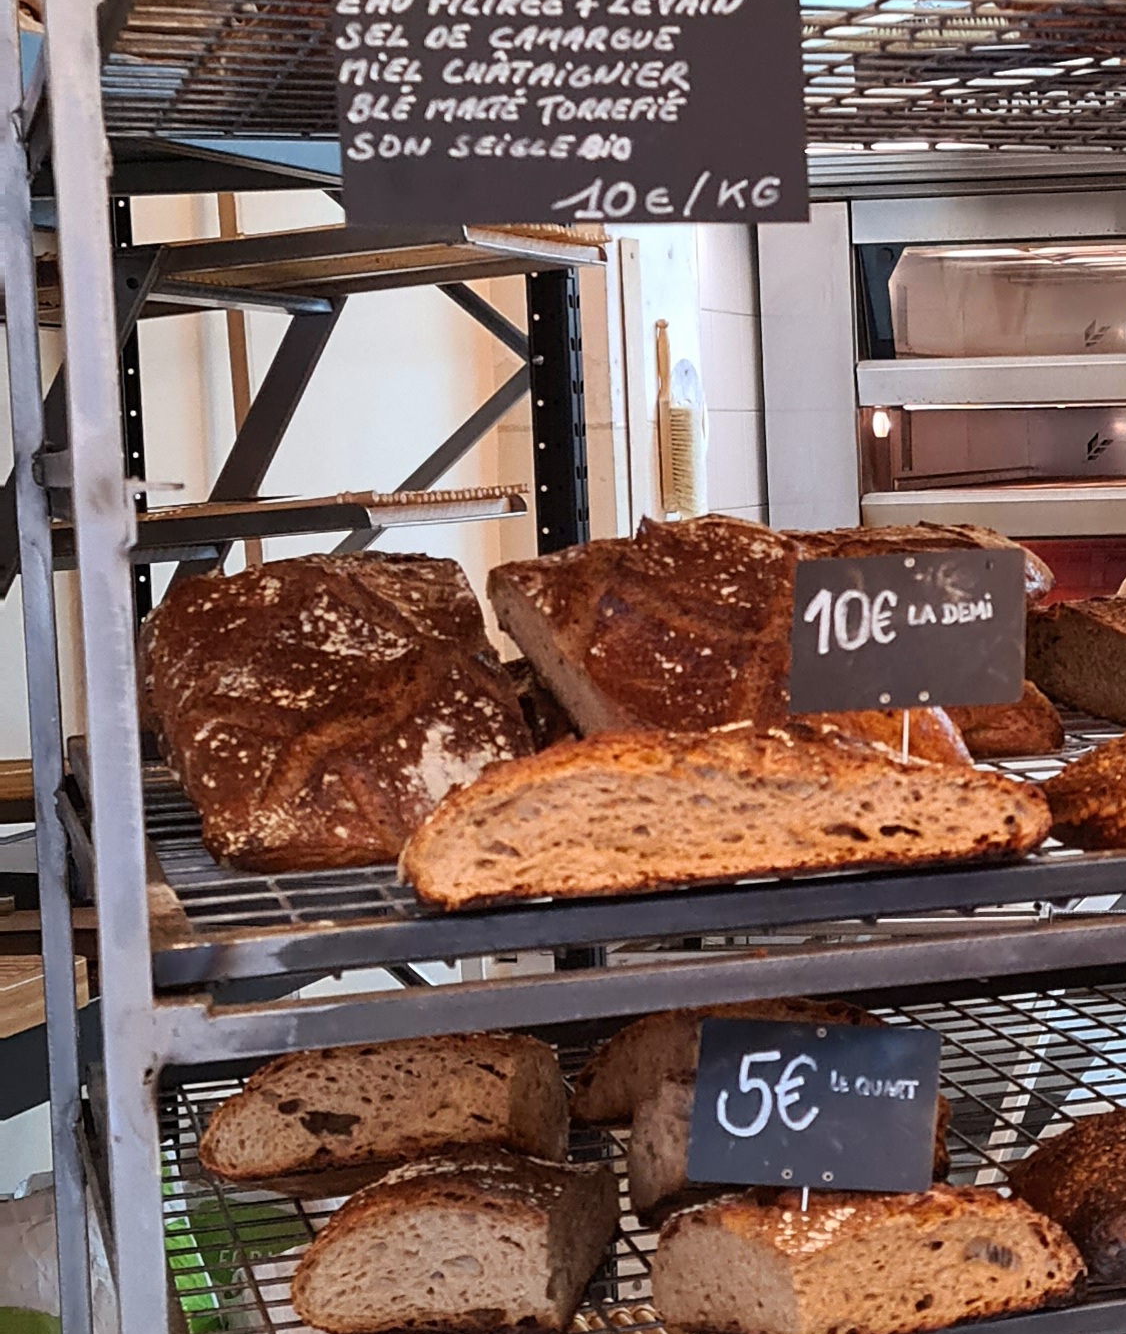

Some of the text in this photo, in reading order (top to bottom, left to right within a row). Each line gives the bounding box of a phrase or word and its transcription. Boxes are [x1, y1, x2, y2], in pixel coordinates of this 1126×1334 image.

[336, 22, 681, 51] SEL DE CAMARGUE
[339, 52, 423, 85] MIEL
[346, 85, 417, 124] BLÉ
[346, 132, 432, 161] SON
[803, 588, 899, 655] 10€
[907, 604, 937, 626] LA
[716, 1050, 920, 1138] 5€ LE QUART
